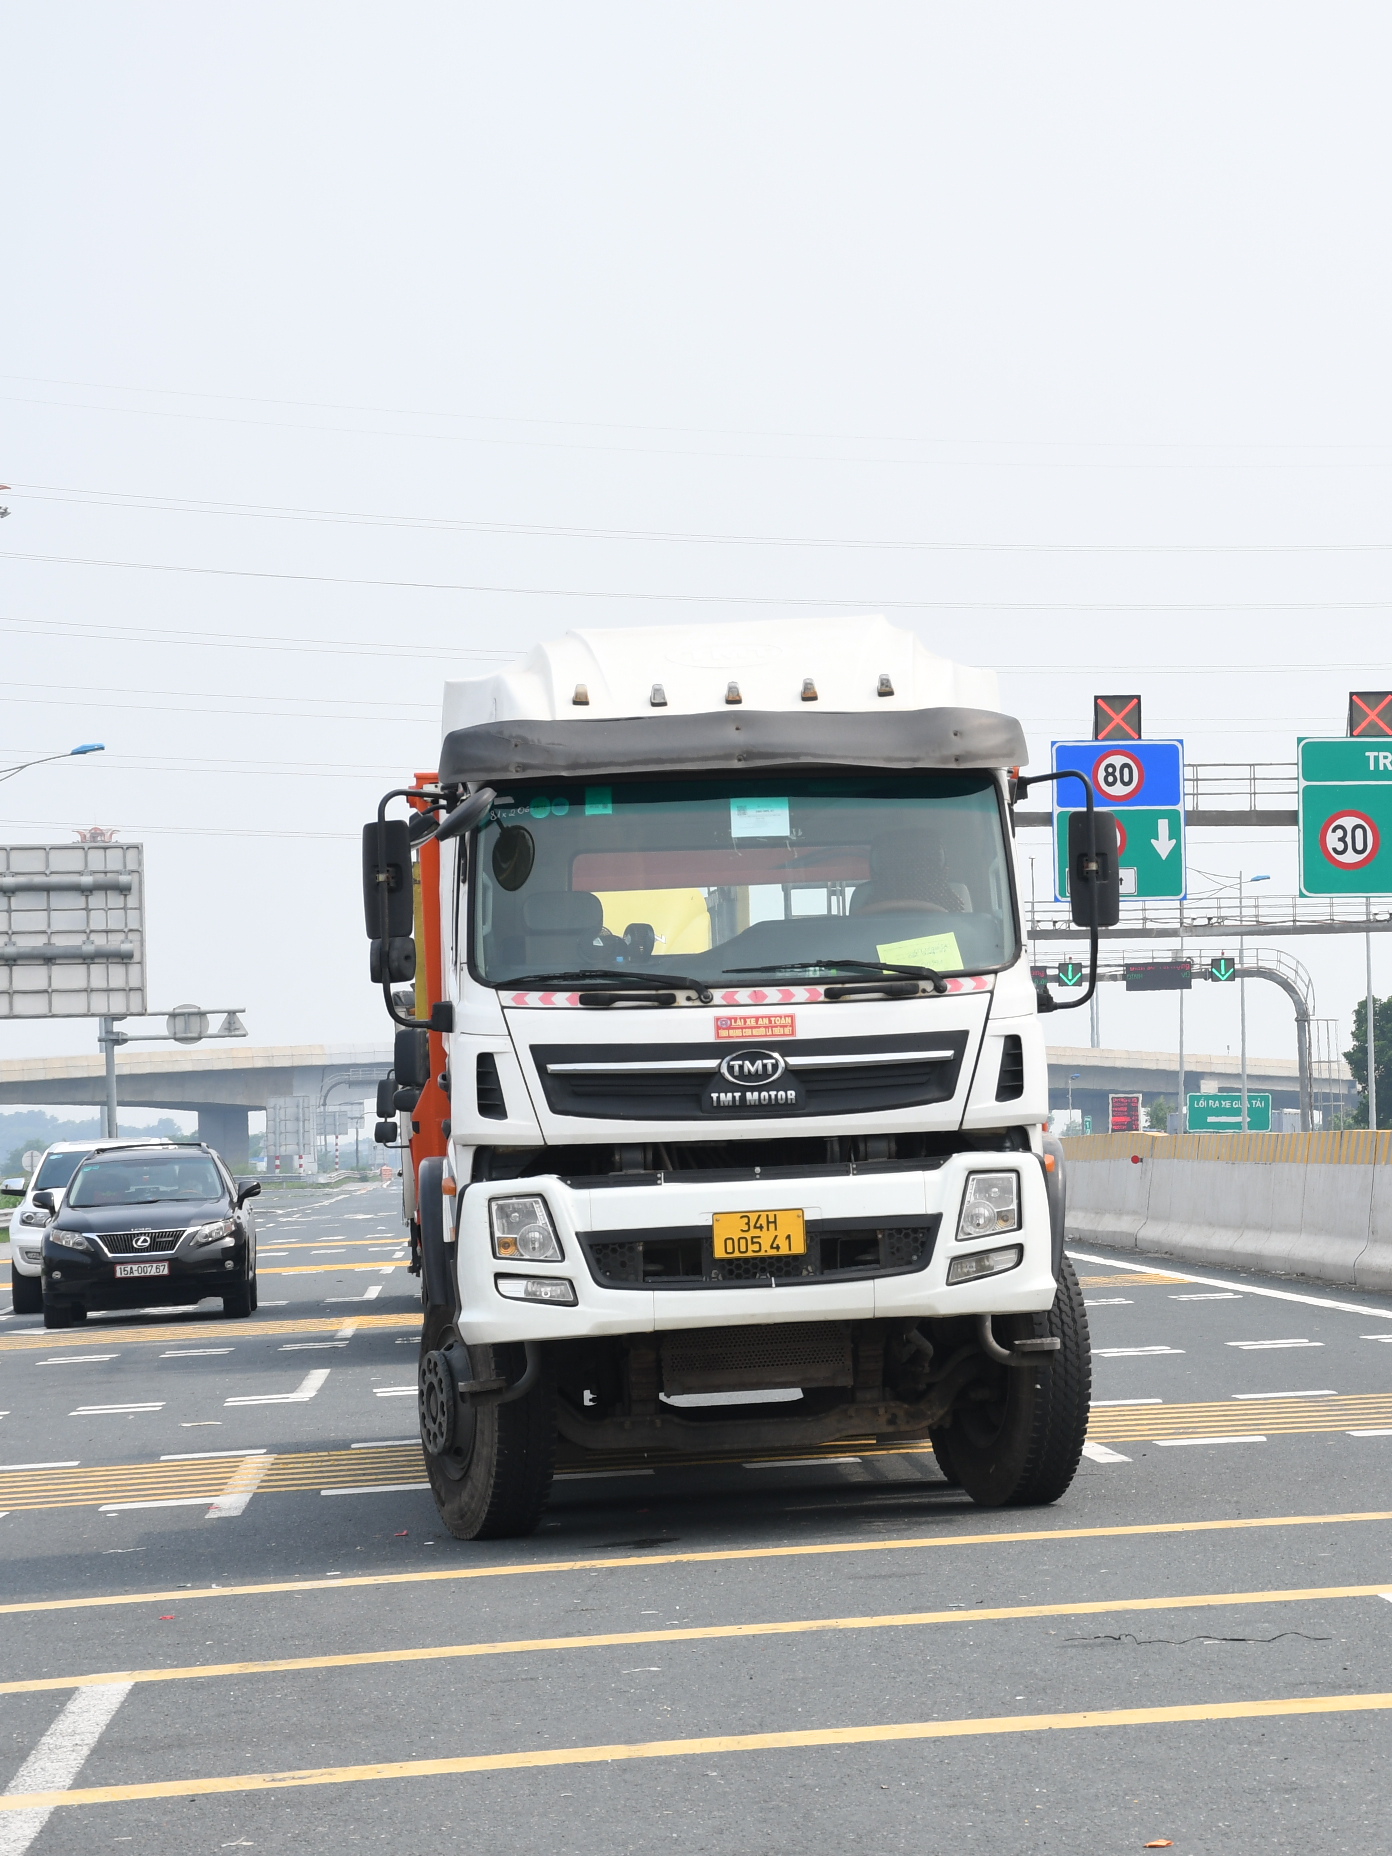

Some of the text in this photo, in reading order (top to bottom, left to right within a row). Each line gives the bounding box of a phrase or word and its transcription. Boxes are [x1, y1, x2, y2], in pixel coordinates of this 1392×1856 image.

[1103, 762, 1134, 787] 80
[1331, 823, 1368, 856] 30
[758, 1017, 769, 1025] AN
[729, 1059, 776, 1076] TMT
[710, 1090, 796, 1106] TMT MOTOR
[1194, 1097, 1207, 1108] LỐI
[1209, 1100, 1219, 1108] RA
[1221, 1100, 1231, 1108] XE
[739, 1213, 778, 1233] 34H
[723, 1233, 792, 1255] 005.41
[118, 1264, 166, 1276] 15A-007.67
